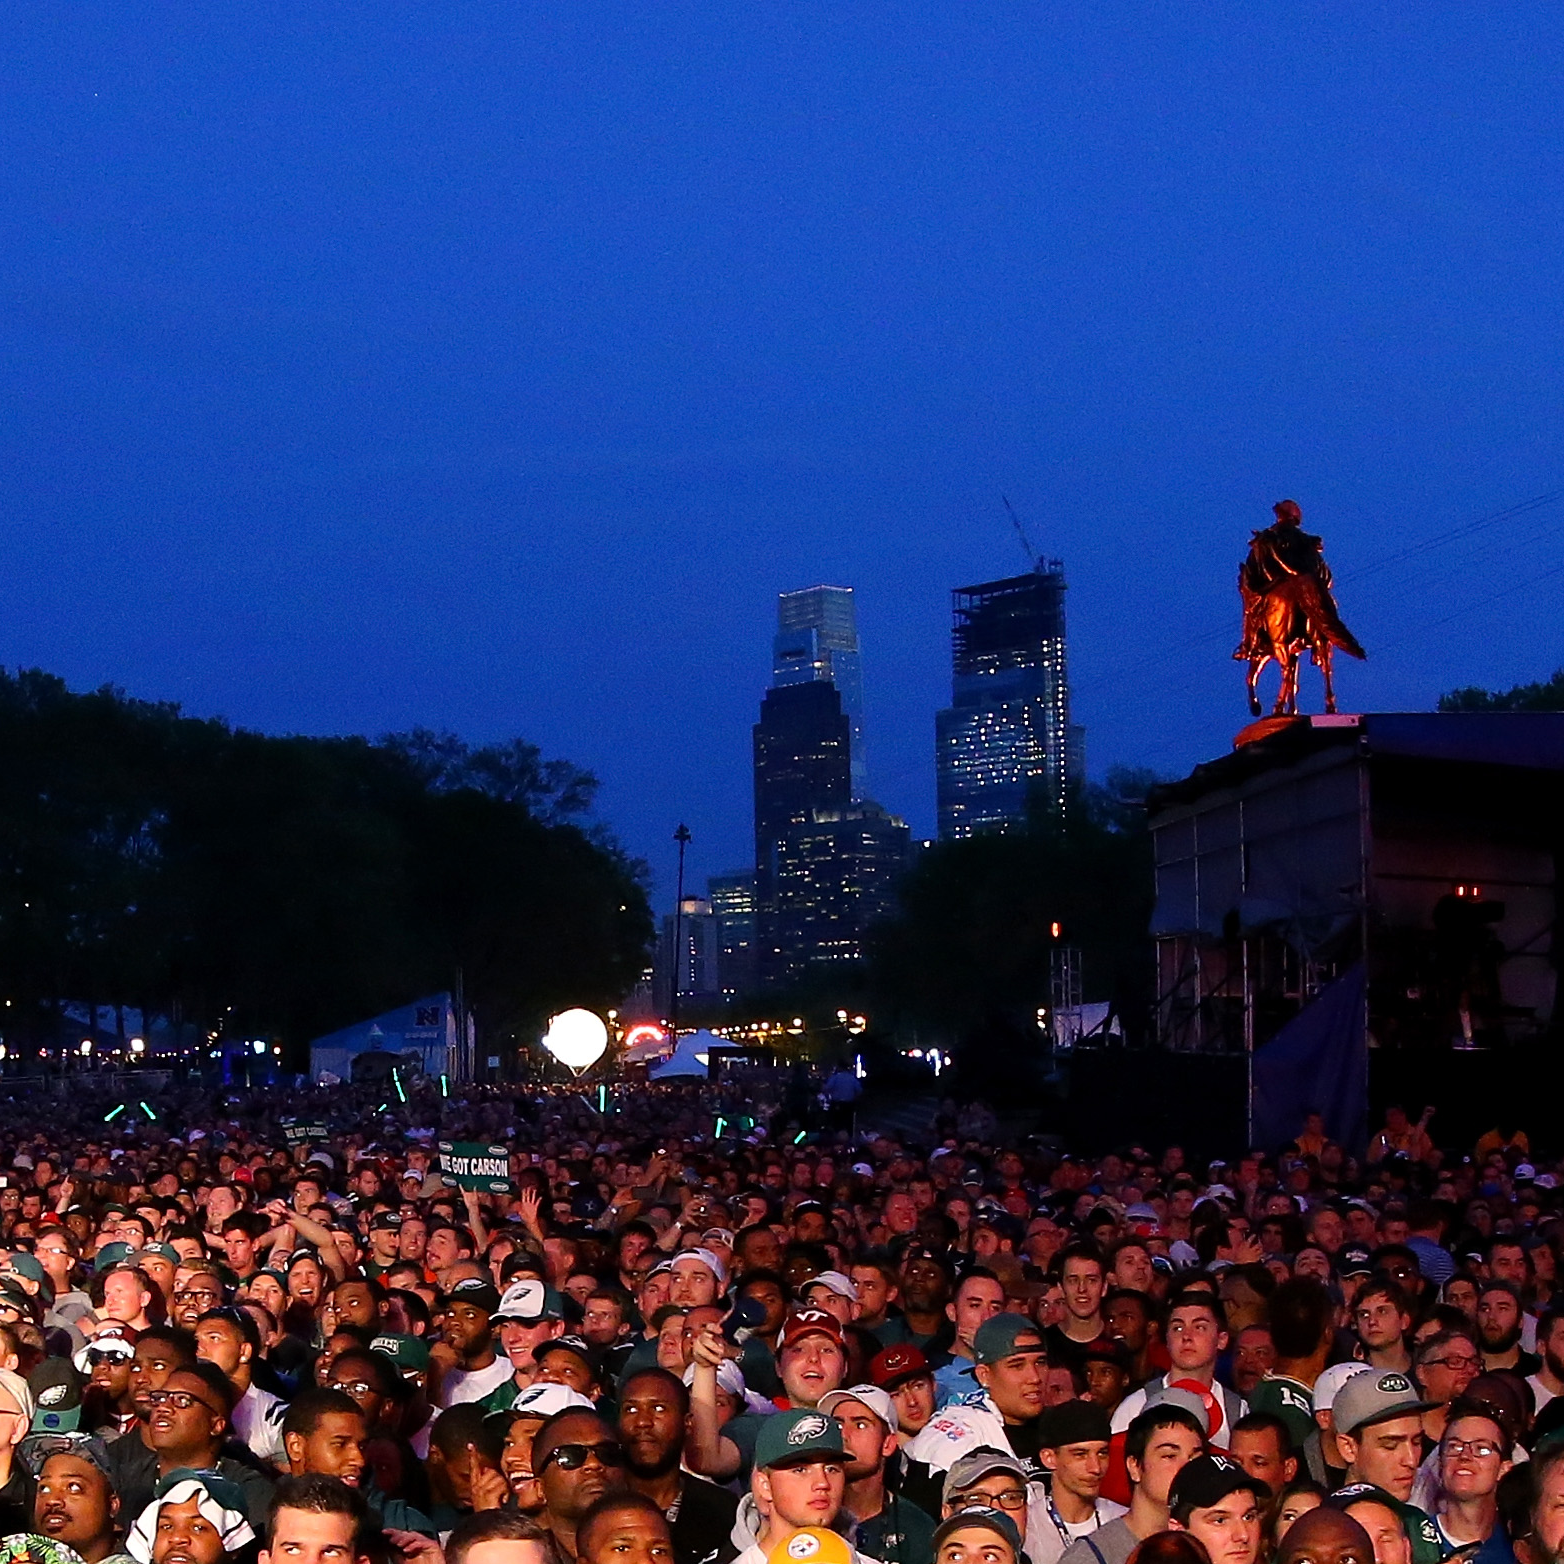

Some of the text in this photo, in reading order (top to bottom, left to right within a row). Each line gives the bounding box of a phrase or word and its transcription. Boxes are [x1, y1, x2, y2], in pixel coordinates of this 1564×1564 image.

[439, 1153, 510, 1177] WE GOT CARSON
